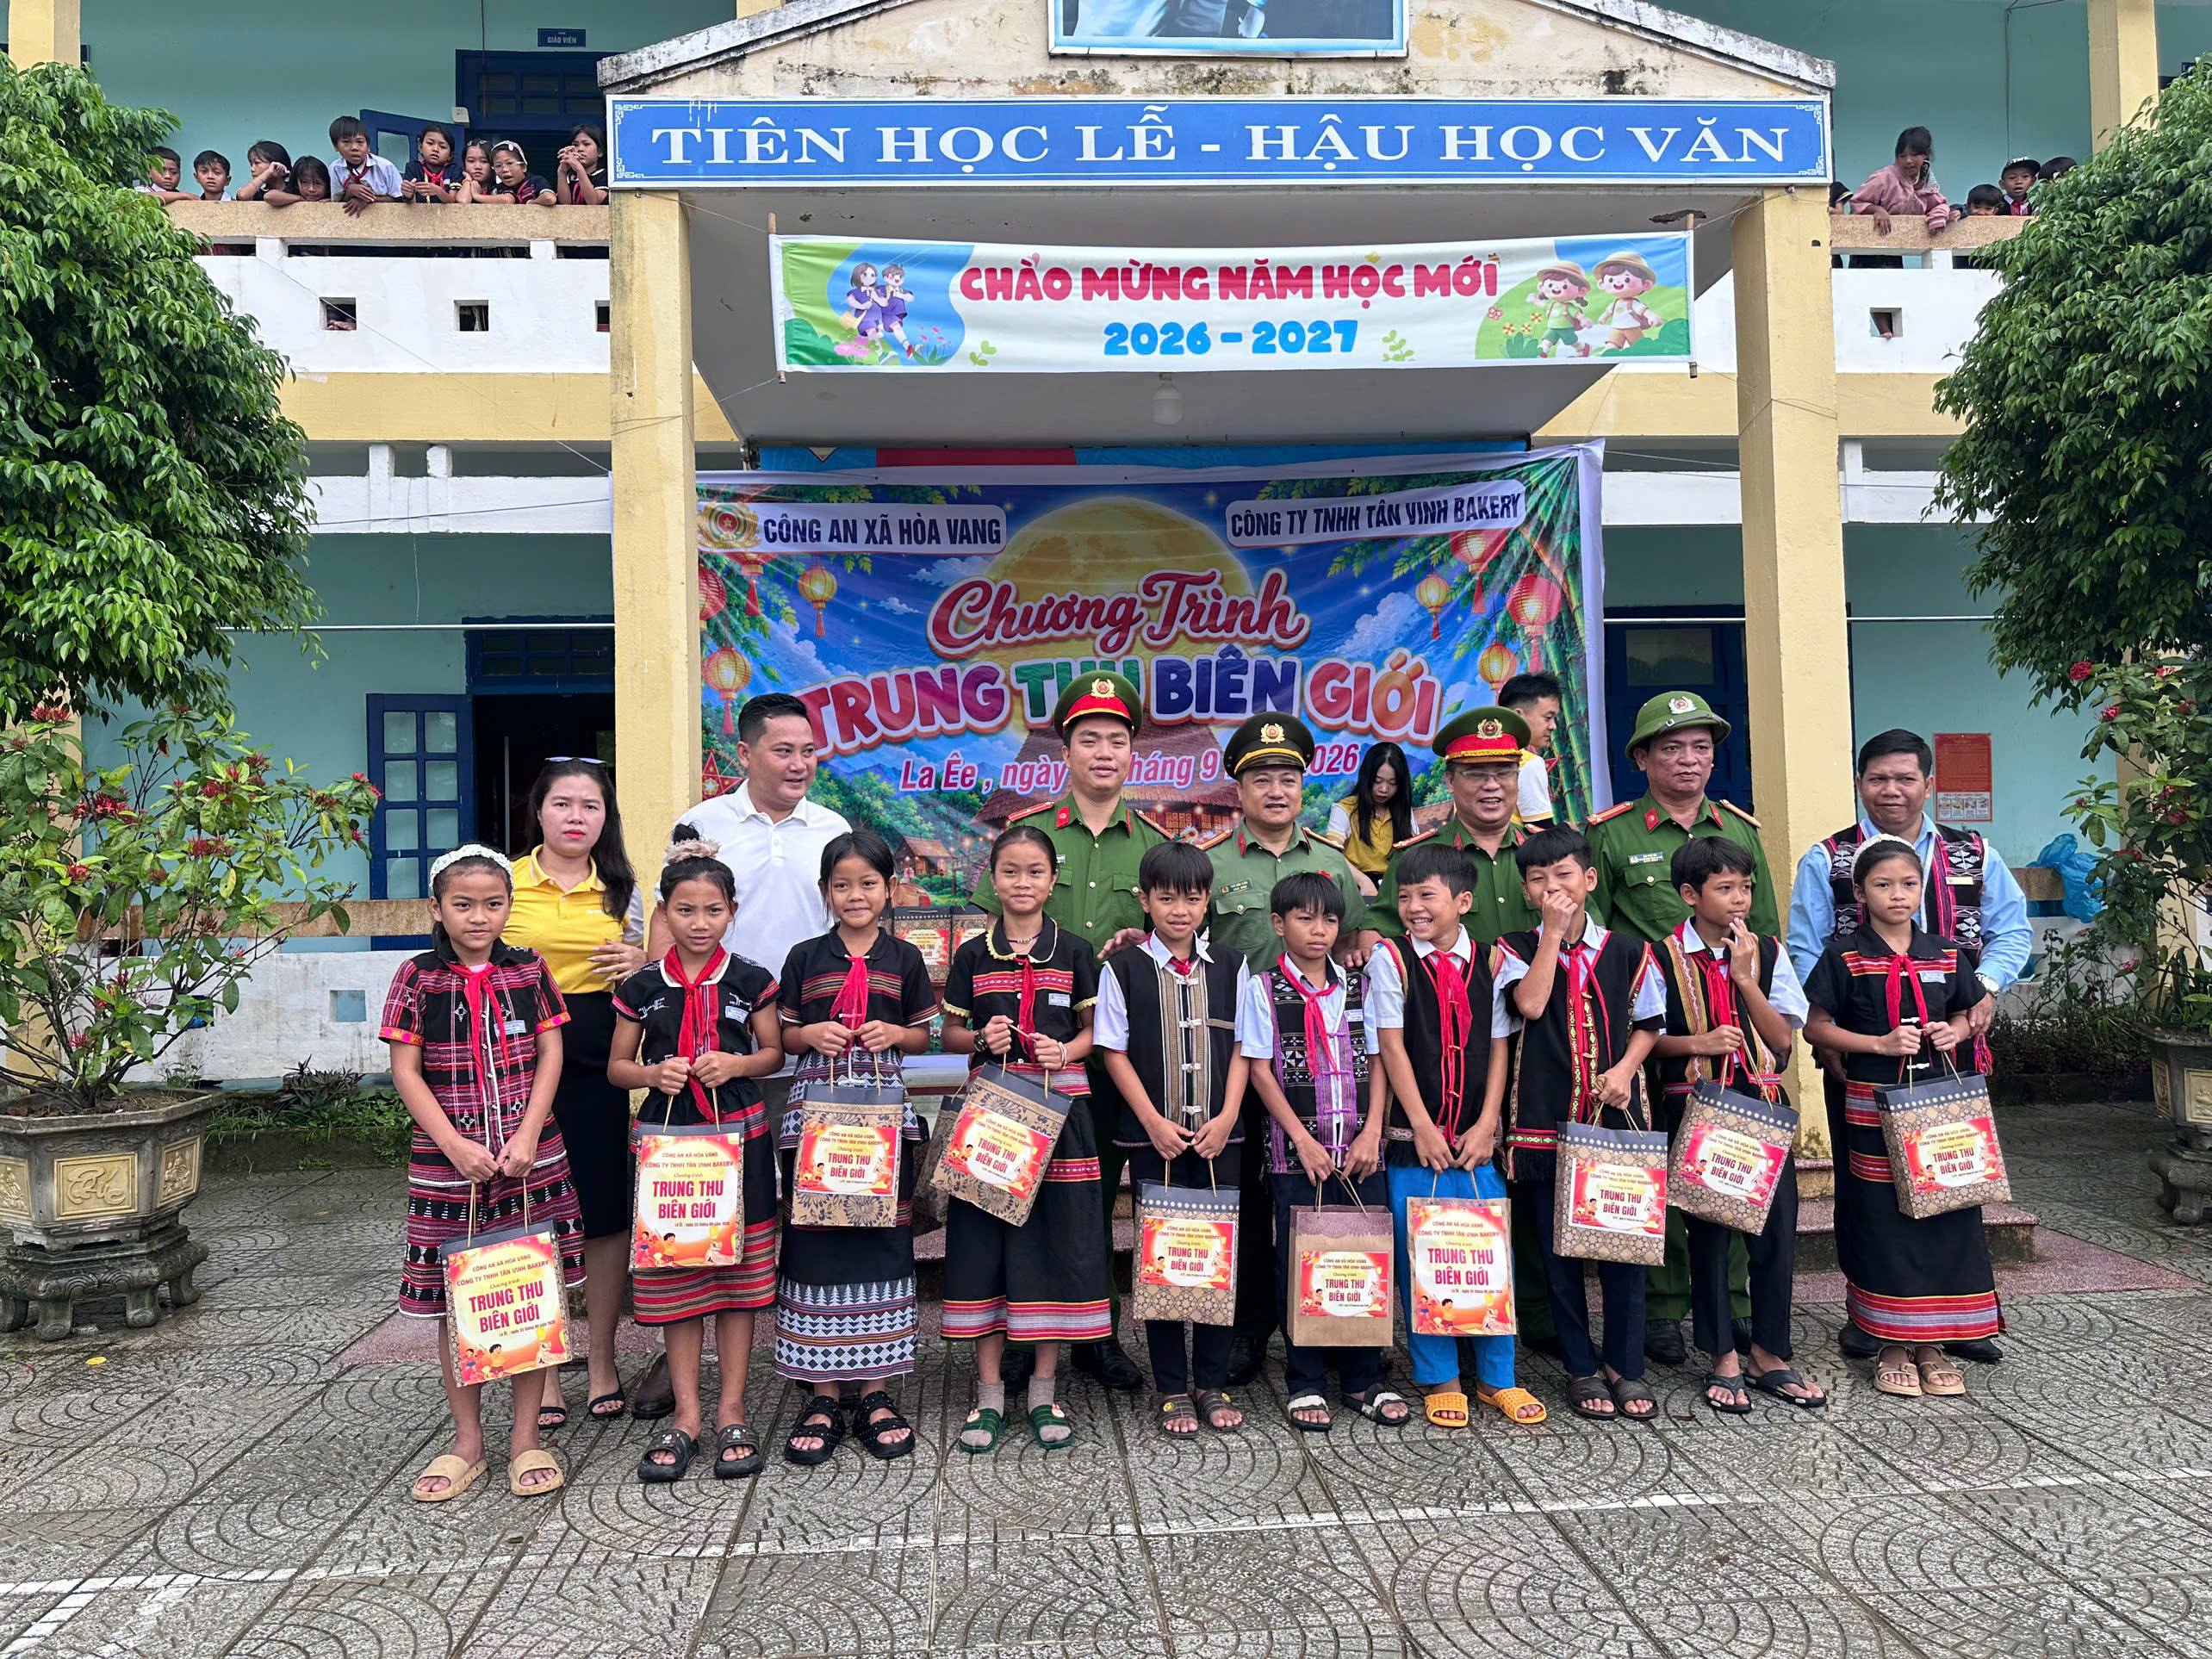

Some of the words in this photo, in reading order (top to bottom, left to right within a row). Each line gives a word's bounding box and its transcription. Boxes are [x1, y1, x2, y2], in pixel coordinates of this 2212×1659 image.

[651, 117, 851, 165] TIÊN
[875, 125, 1049, 173] HỌC
[1074, 104, 1176, 162] LỄ
[1201, 143, 1221, 152] -
[1245, 114, 1415, 171] HẬU
[1439, 125, 1606, 172] HỌC
[1626, 116, 1790, 164] VĂN
[960, 258, 1073, 301] CHÀO
[1081, 258, 1210, 301] MỪNG
[1218, 258, 1314, 301] NĂM
[1322, 264, 1406, 309] HỌC
[1414, 255, 1498, 297] MỚI
[1103, 321, 1212, 356] 2026
[1220, 332, 1243, 343] -
[1252, 320, 1358, 354] 2027
[1231, 509, 1282, 537] CÔNG
[1287, 510, 1308, 535] TY
[1314, 506, 1361, 533] TNHH
[1366, 500, 1401, 529] TÂN
[1406, 498, 1449, 525] VINH
[1453, 493, 1521, 523] BAKERY
[763, 513, 822, 544] CÔNG
[828, 519, 858, 544] AN
[864, 514, 893, 544] XÃ
[898, 513, 941, 545] HÒA
[947, 519, 1001, 544] VANG
[932, 579, 1144, 654] Chương
[1142, 569, 1305, 641] Trình
[798, 662, 1005, 750] TRUNG
[1155, 644, 1298, 716] BIÊN
[1309, 651, 1437, 736] GIỚI
[902, 761, 933, 789] La
[1002, 755, 1068, 792] ngày
[1126, 752, 1192, 786] háng
[1201, 750, 1218, 779] 9
[1310, 743, 1359, 774] 026
[828, 1153, 853, 1164] TRUNG
[855, 1154, 870, 1165] THU
[976, 1137, 1002, 1155] TRUNG
[1001, 1148, 1016, 1162] THU
[1932, 1150, 1958, 1162] TRUNG
[1959, 1146, 1974, 1158] THU
[1710, 1153, 1737, 1169] TRUNG
[1737, 1161, 1752, 1174] THU
[652, 1180, 693, 1197] TRUNG
[699, 1179, 724, 1196] THU
[1599, 1190, 1625, 1201] TRUNG
[1626, 1193, 1641, 1203] THU
[658, 1198, 686, 1219] BIÊN
[690, 1197, 716, 1218] GIỚI
[1167, 1246, 1191, 1257] TRUNG
[1194, 1248, 1208, 1258] THU
[1427, 1247, 1466, 1264] TRUNG
[1469, 1249, 1494, 1264] THU
[1325, 1278, 1348, 1288] TRUNG
[1351, 1279, 1364, 1289] THU
[1435, 1264, 1461, 1284] BIÊN
[1465, 1265, 1488, 1286] GIỚI
[468, 1288, 515, 1313] TRUNG
[516, 1280, 544, 1301] THU
[477, 1308, 510, 1333] BIÊN
[512, 1300, 540, 1324] GIỚI
